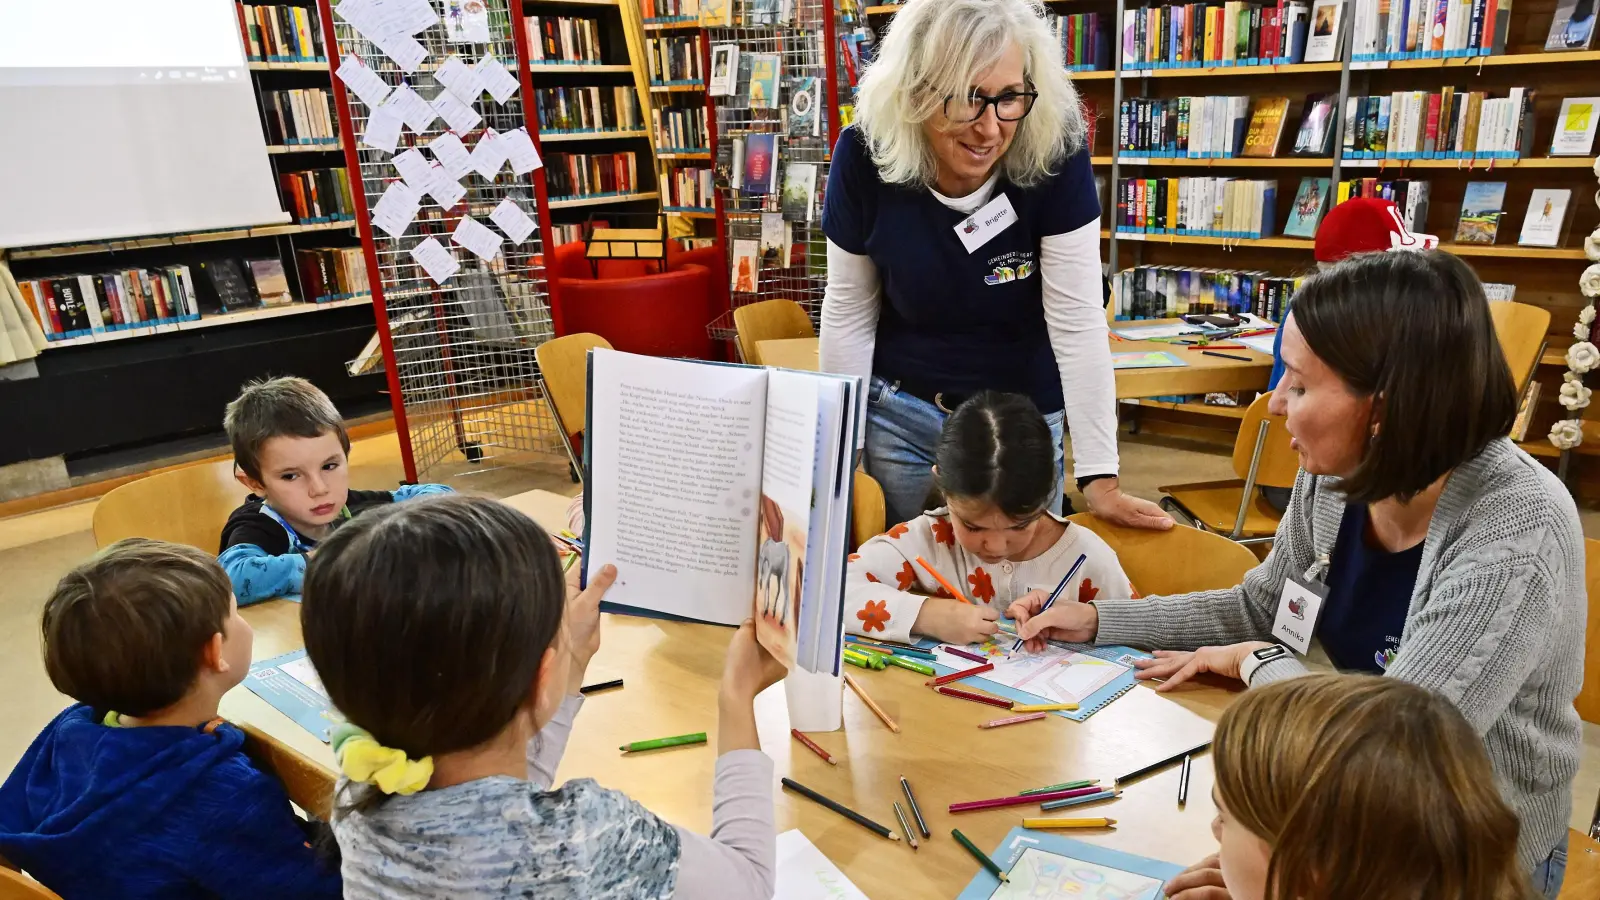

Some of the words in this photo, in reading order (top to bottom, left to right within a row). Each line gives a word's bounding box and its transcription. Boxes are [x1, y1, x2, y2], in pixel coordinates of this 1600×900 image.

[1246, 135, 1274, 146] GOLD
[985, 208, 1008, 227] Brigitte
[62, 288, 75, 310] BOYLE
[1281, 624, 1304, 643] Annika
